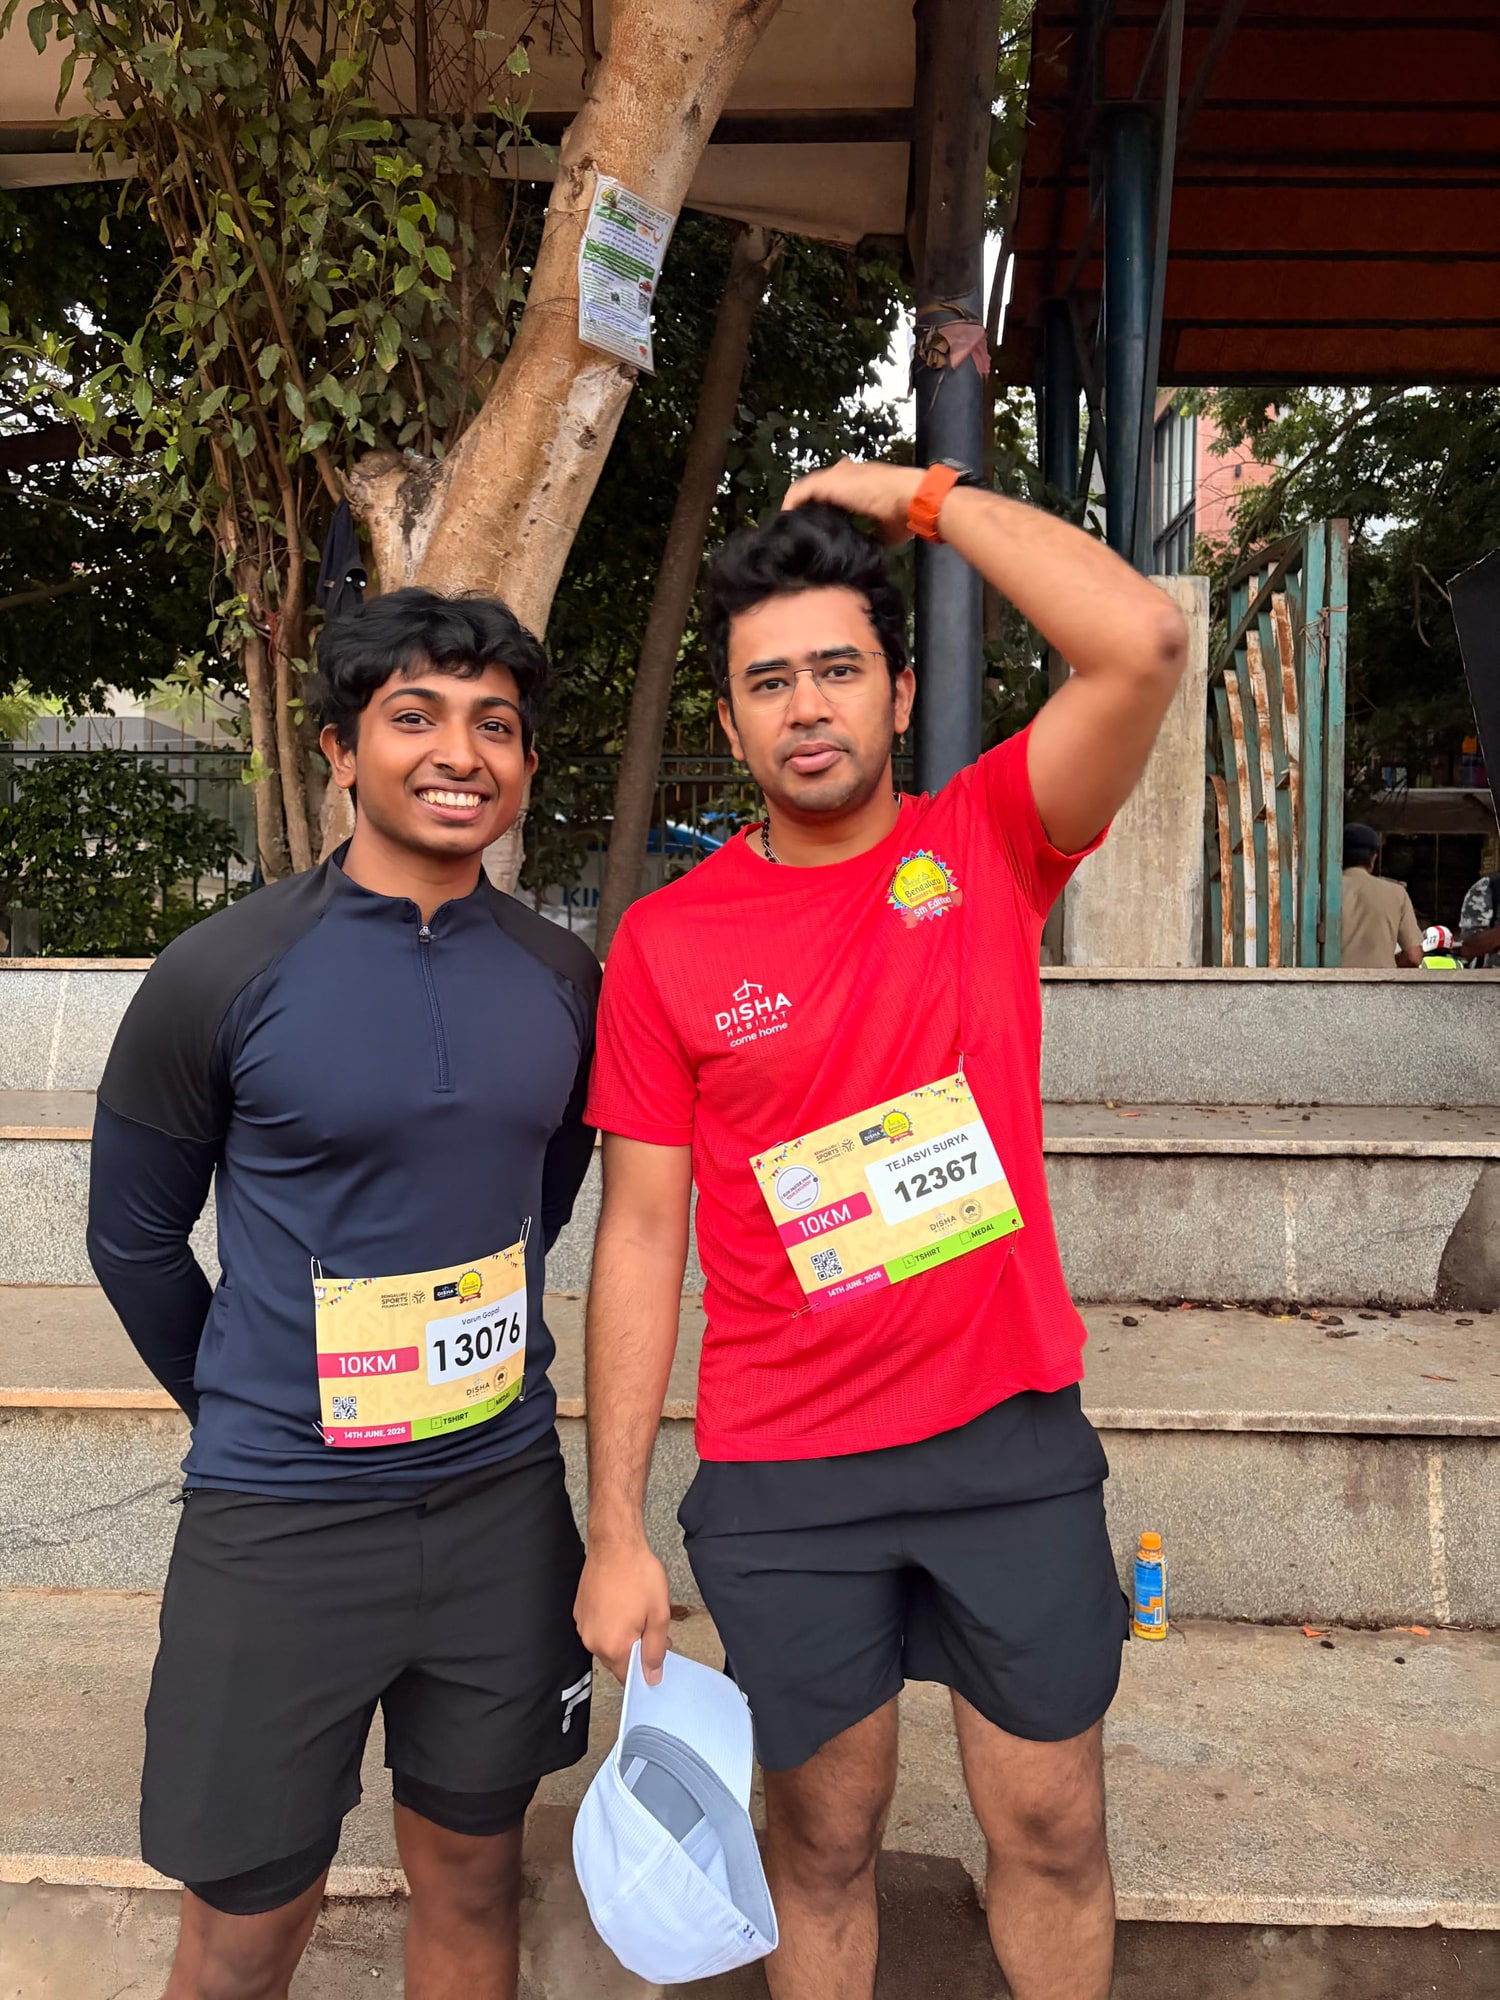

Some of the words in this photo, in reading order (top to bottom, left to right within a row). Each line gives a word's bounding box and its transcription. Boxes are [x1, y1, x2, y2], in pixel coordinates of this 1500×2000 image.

[904, 878, 942, 898] Bengaluru
[913, 905, 928, 917] 5th
[927, 895, 952, 910] Edition
[714, 992, 792, 1032] DISHA
[726, 1011, 788, 1038] HABITAT
[729, 1031, 758, 1048] come
[758, 1021, 789, 1038] home
[816, 1147, 840, 1161] SPORTS
[885, 1147, 932, 1173] TEJASVI
[933, 1132, 969, 1158] SURYA
[894, 1151, 979, 1203] 12367
[798, 1203, 852, 1238] 10KM
[929, 1215, 957, 1231] DISHA
[914, 1246, 941, 1262] TSHIRT
[971, 1223, 995, 1239] MEDAL
[827, 1285, 846, 1298] 14TH
[845, 1278, 865, 1291] JUNE,
[864, 1270, 882, 1283] 2026
[381, 1296, 409, 1305] SPORTS
[461, 1314, 482, 1326] Varun
[482, 1306, 500, 1321] Gopal
[433, 1311, 521, 1372] 13076
[338, 1353, 397, 1375] 10KM
[466, 1382, 490, 1396] DISHA
[443, 1411, 469, 1425] TSHIRT
[495, 1391, 511, 1406] MEDAL
[344, 1429, 363, 1439] 14TH
[364, 1428, 386, 1439] JUNE,
[387, 1426, 406, 1437] 2026
